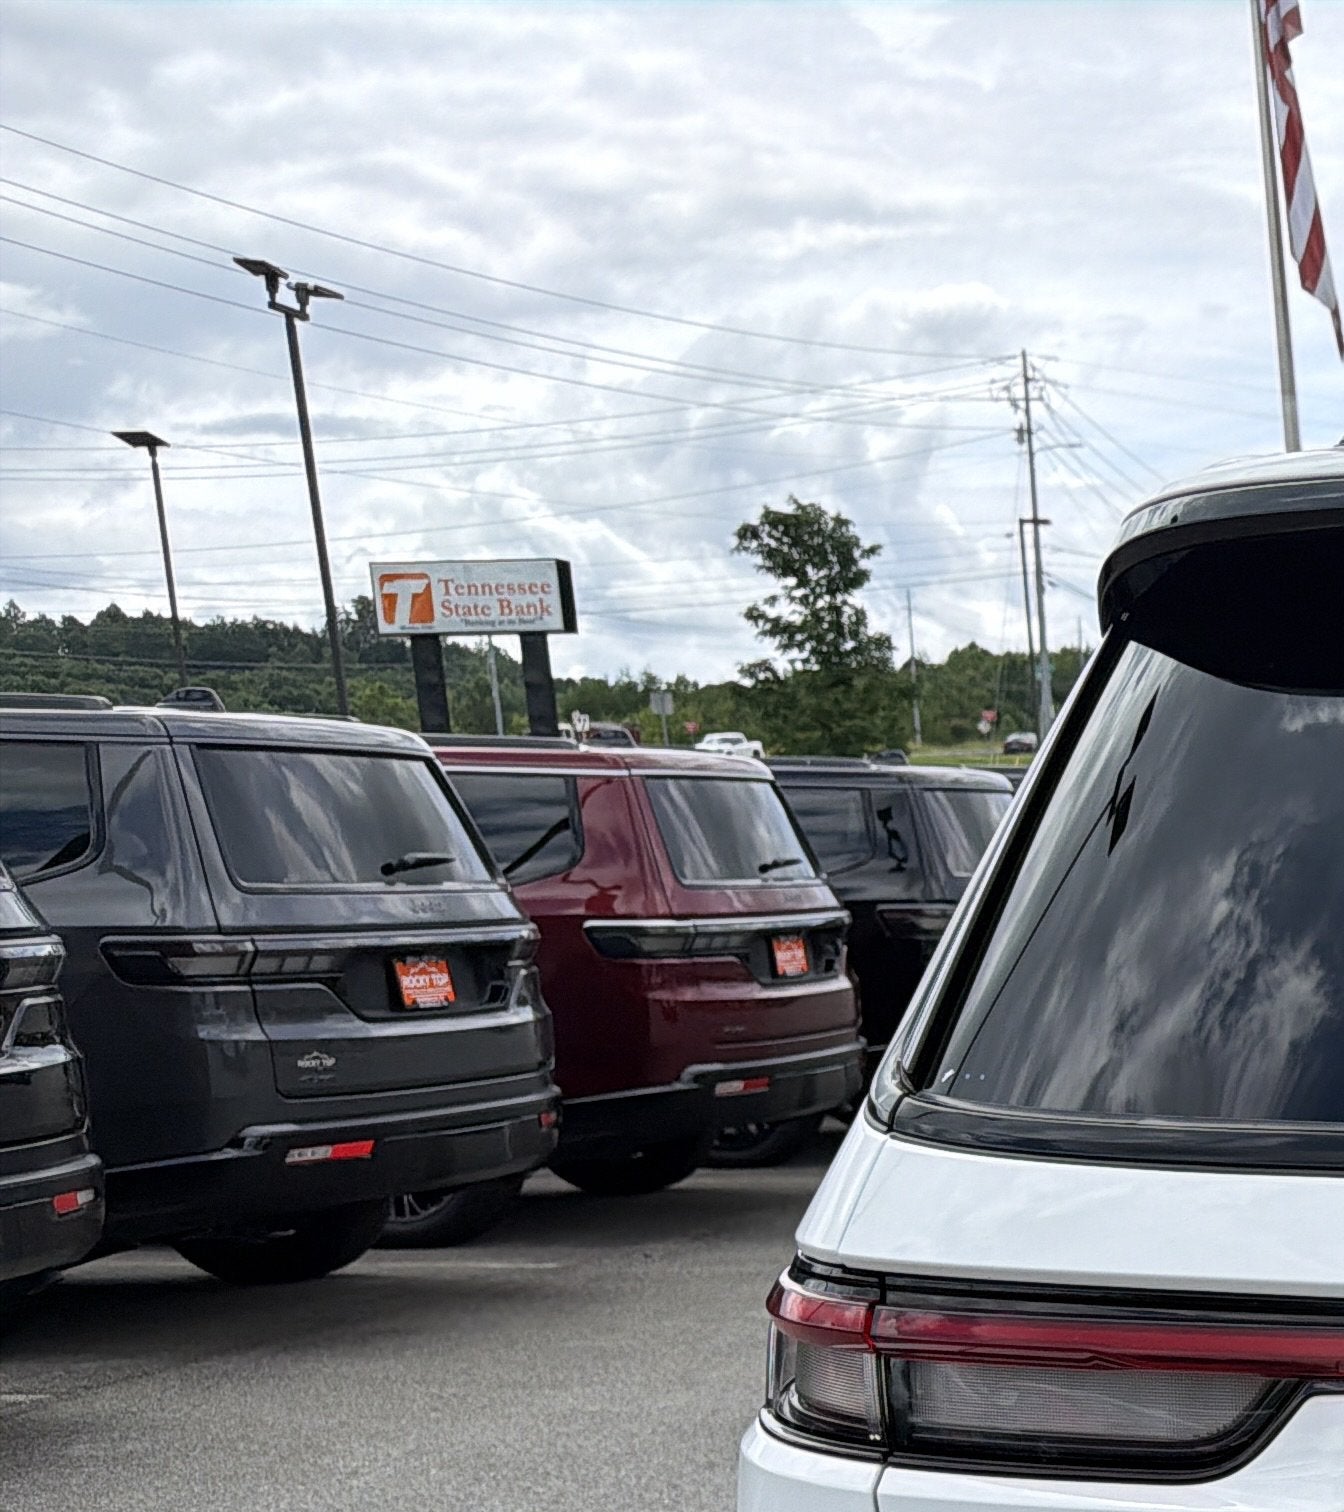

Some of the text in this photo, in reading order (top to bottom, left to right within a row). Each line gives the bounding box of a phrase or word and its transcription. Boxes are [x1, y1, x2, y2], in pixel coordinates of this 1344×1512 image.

[437, 578, 552, 597] Tennessee
[440, 597, 552, 617] State Bank
